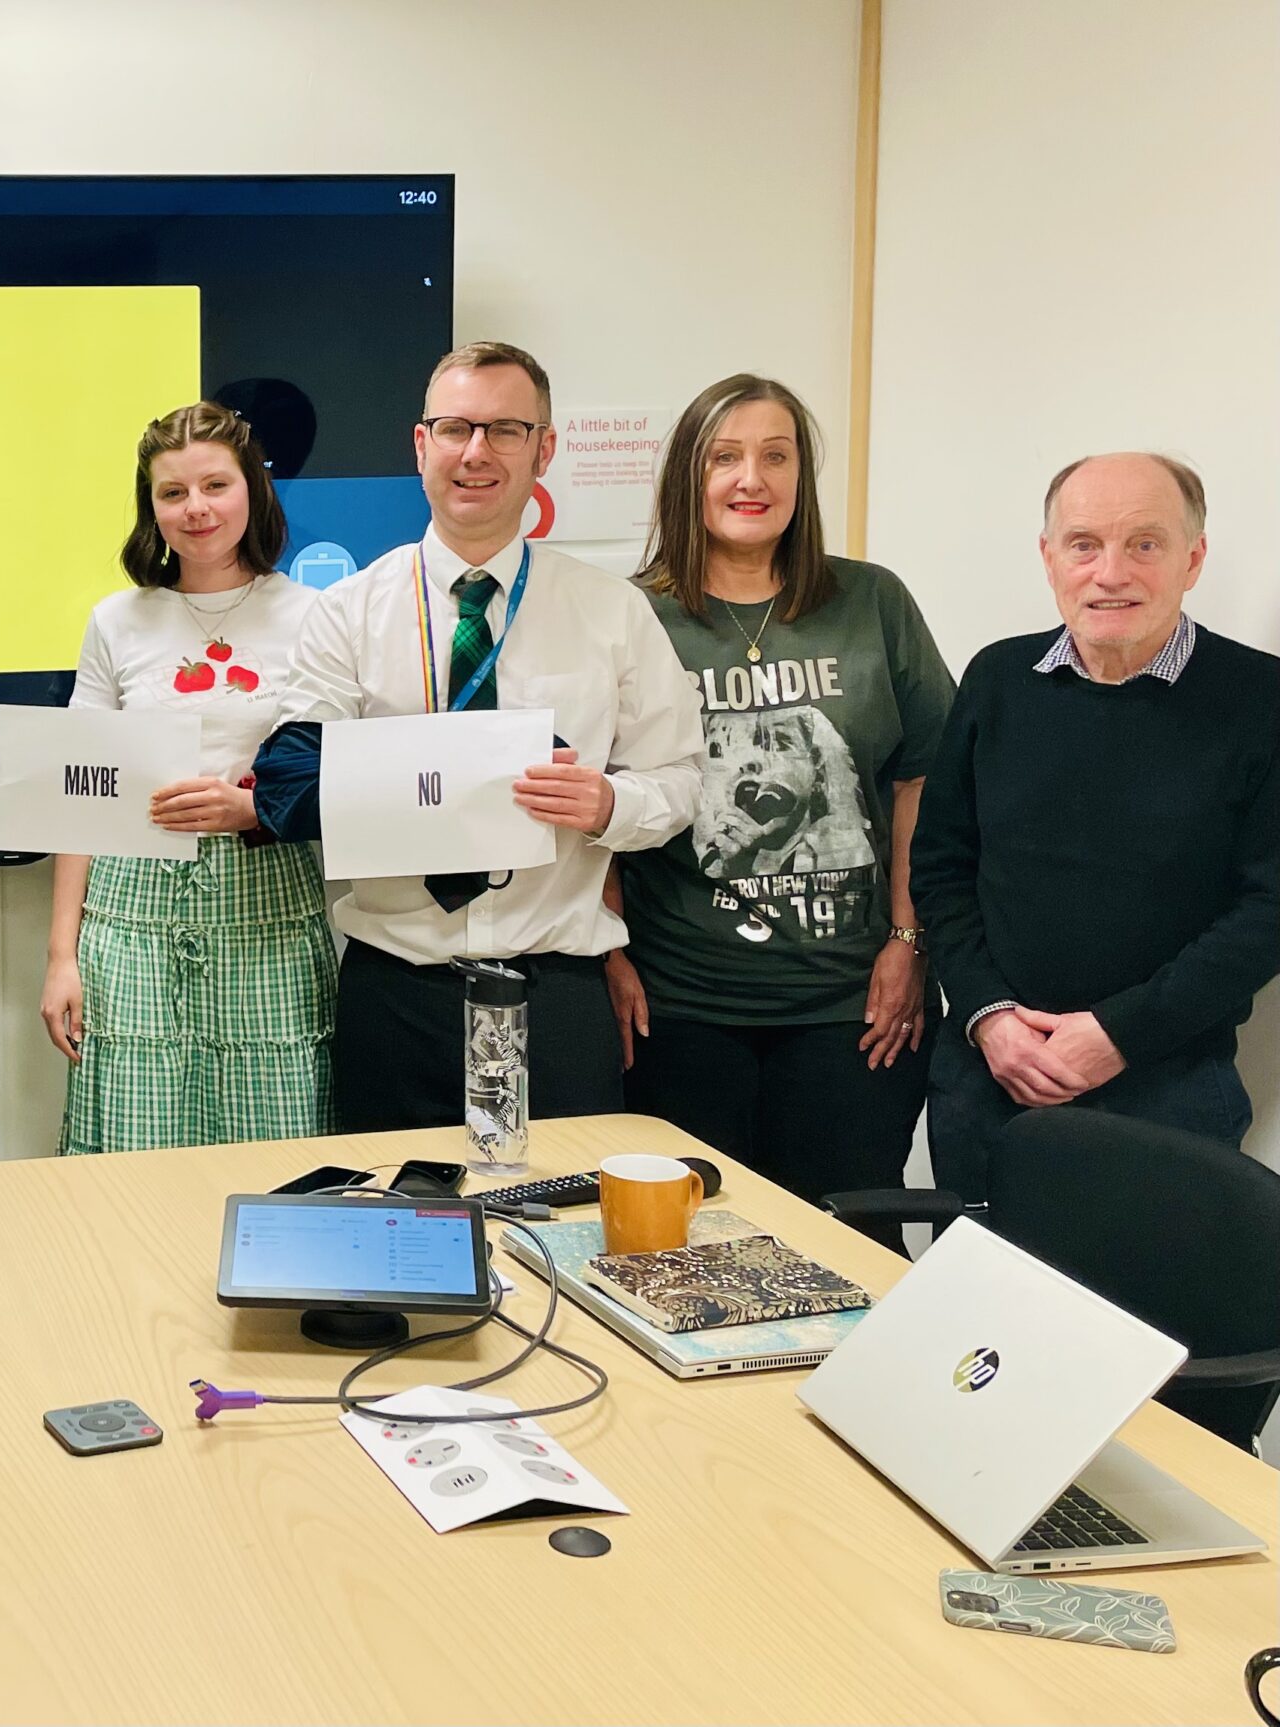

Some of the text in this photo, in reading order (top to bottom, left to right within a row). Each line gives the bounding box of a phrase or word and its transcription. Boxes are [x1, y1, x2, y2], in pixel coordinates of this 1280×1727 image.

[398, 190, 438, 205] 12:40
[566, 417, 648, 433] A little bit of
[567, 438, 660, 454] housekeeping
[64, 764, 120, 798] MAYBE
[418, 770, 442, 807] NO
[772, 873, 808, 897] NEW
